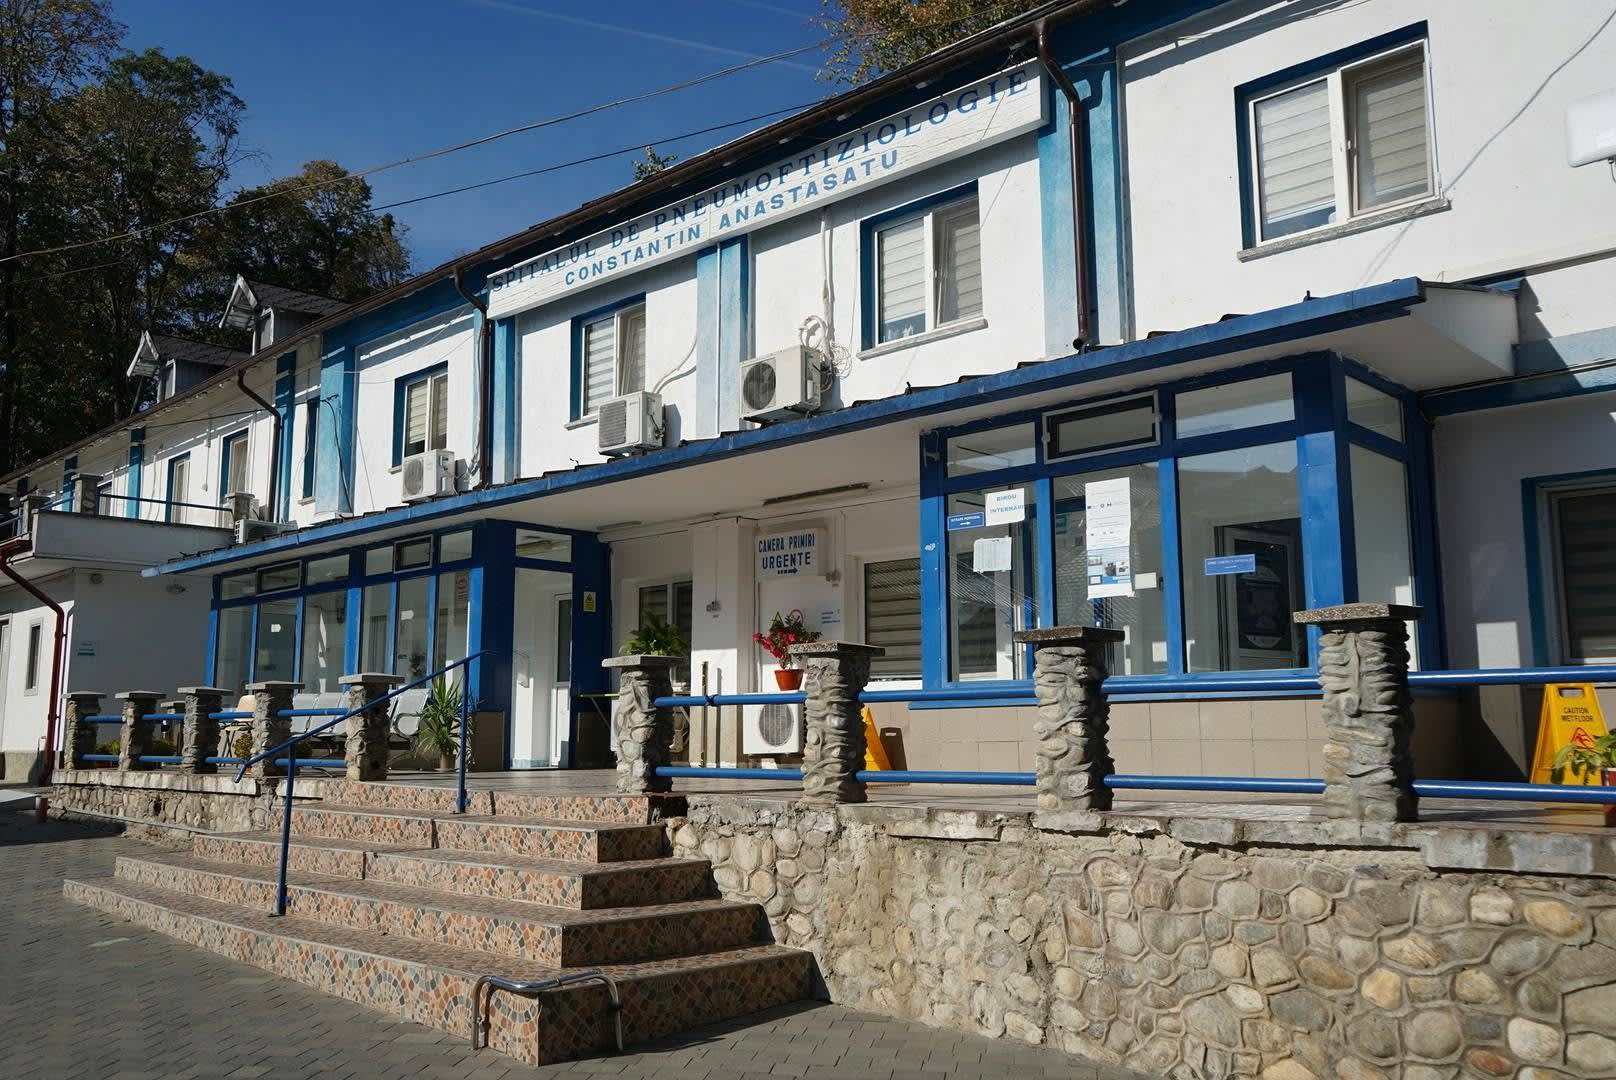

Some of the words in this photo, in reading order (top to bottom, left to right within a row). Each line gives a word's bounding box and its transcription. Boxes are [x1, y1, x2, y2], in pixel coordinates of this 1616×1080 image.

[491, 241, 597, 292] SPITALUL
[610, 223, 640, 249] DE
[654, 70, 1029, 232] PNEUMOFTIZIOLOGIE
[565, 224, 701, 286] CONSTANTIN
[719, 150, 898, 230] ANASTASATU
[758, 537, 785, 552] CAMERA
[788, 533, 815, 549] PRIMIRI
[762, 552, 811, 569] URGENTE
